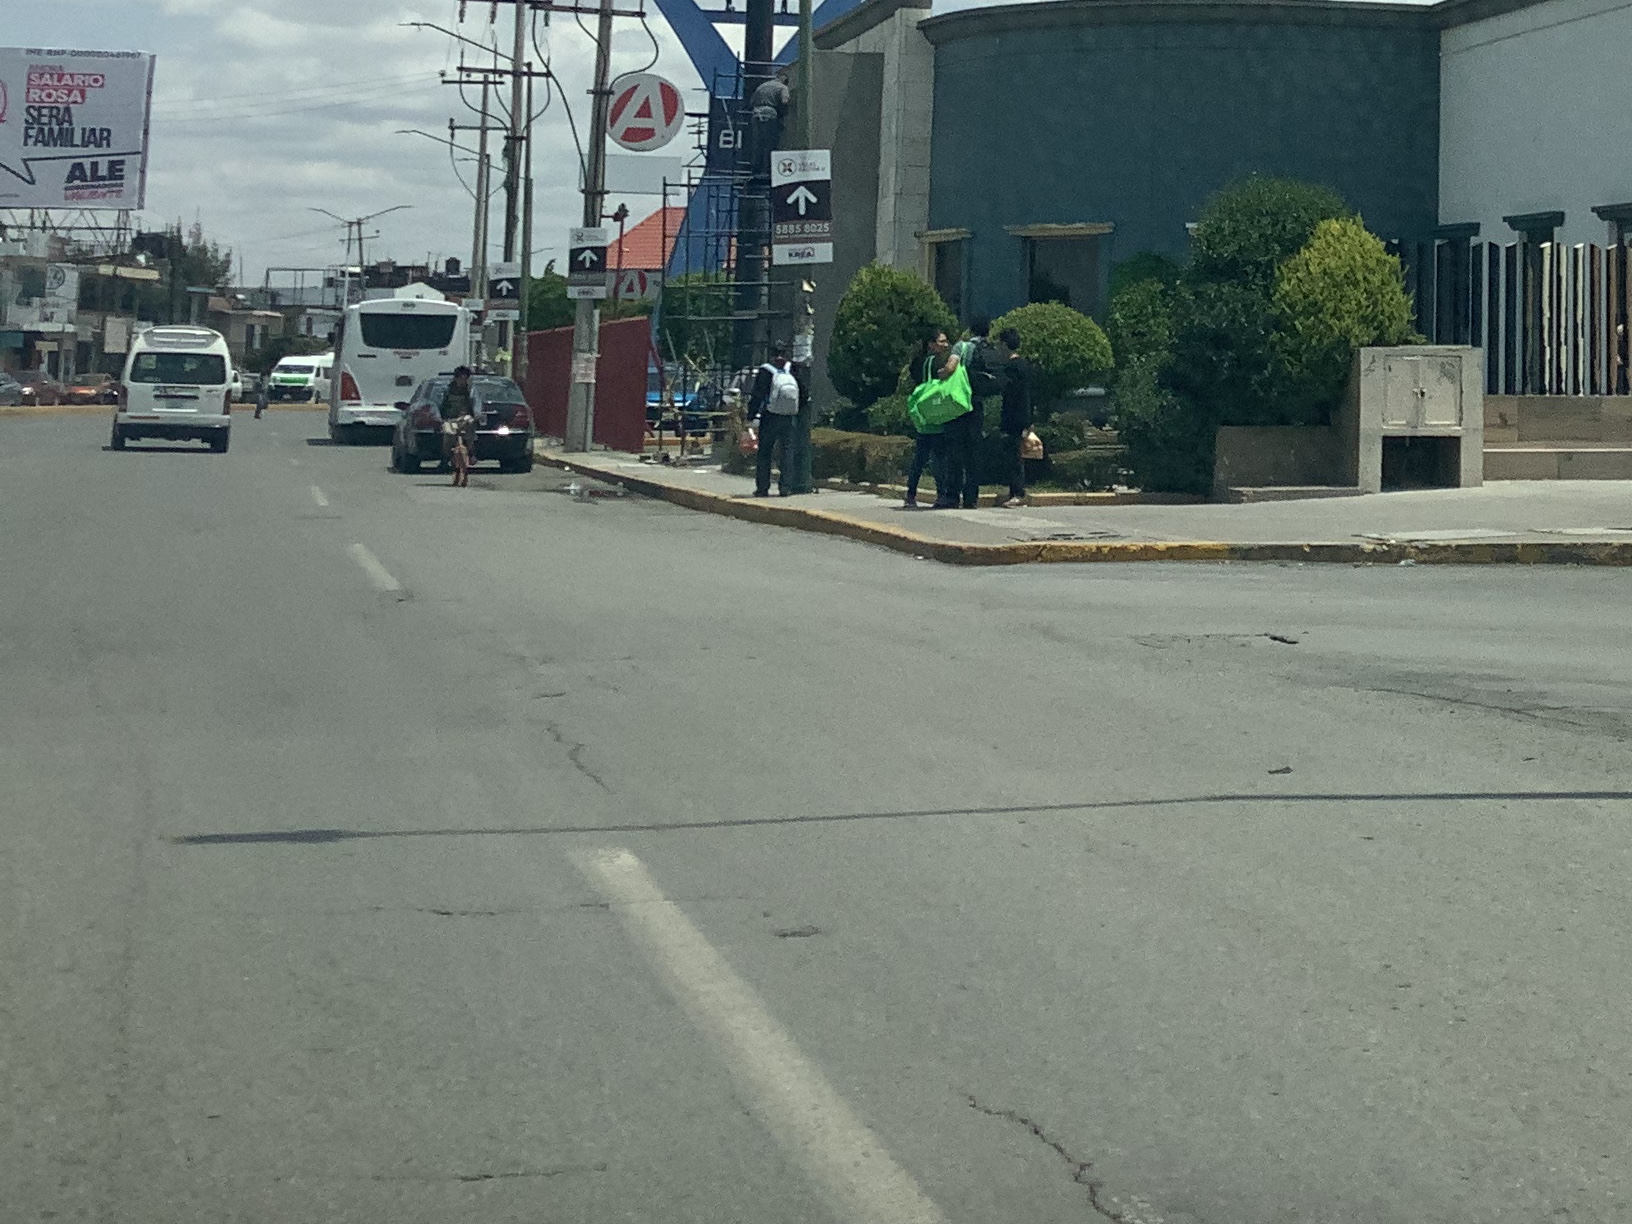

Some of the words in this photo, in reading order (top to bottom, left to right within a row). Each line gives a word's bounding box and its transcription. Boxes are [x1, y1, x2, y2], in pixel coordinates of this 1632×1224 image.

[29, 73, 103, 87] SALARIO
[28, 88, 83, 104] ROSA
[609, 77, 673, 147] A
[23, 127, 112, 149] FAMILIAR
[65, 159, 126, 184] ALE
[775, 223, 802, 235] 5885
[803, 222, 830, 234] 8025
